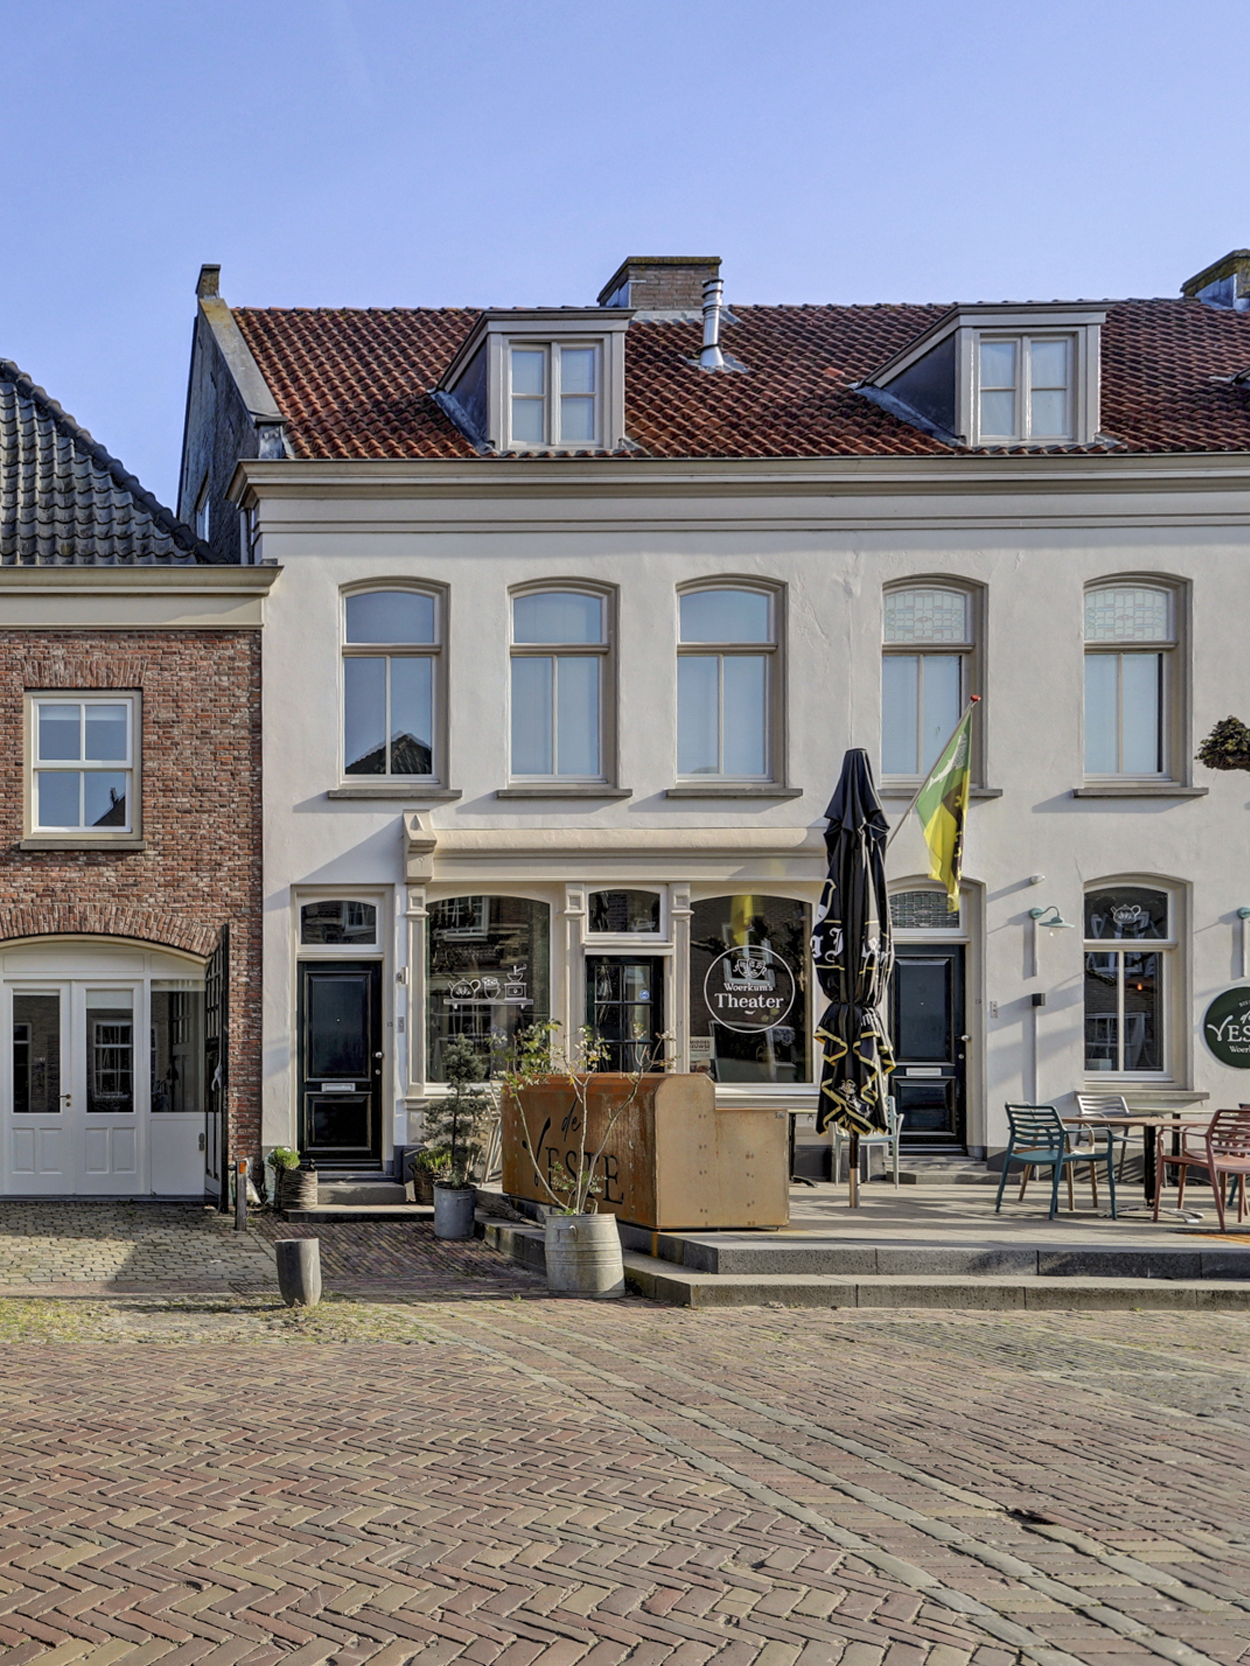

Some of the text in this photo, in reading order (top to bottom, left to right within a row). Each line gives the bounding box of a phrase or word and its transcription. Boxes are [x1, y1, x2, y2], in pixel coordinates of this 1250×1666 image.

[723, 982, 773, 992] Woerkum's
[714, 993, 784, 1008] Theater
[561, 1098, 582, 1142] de
